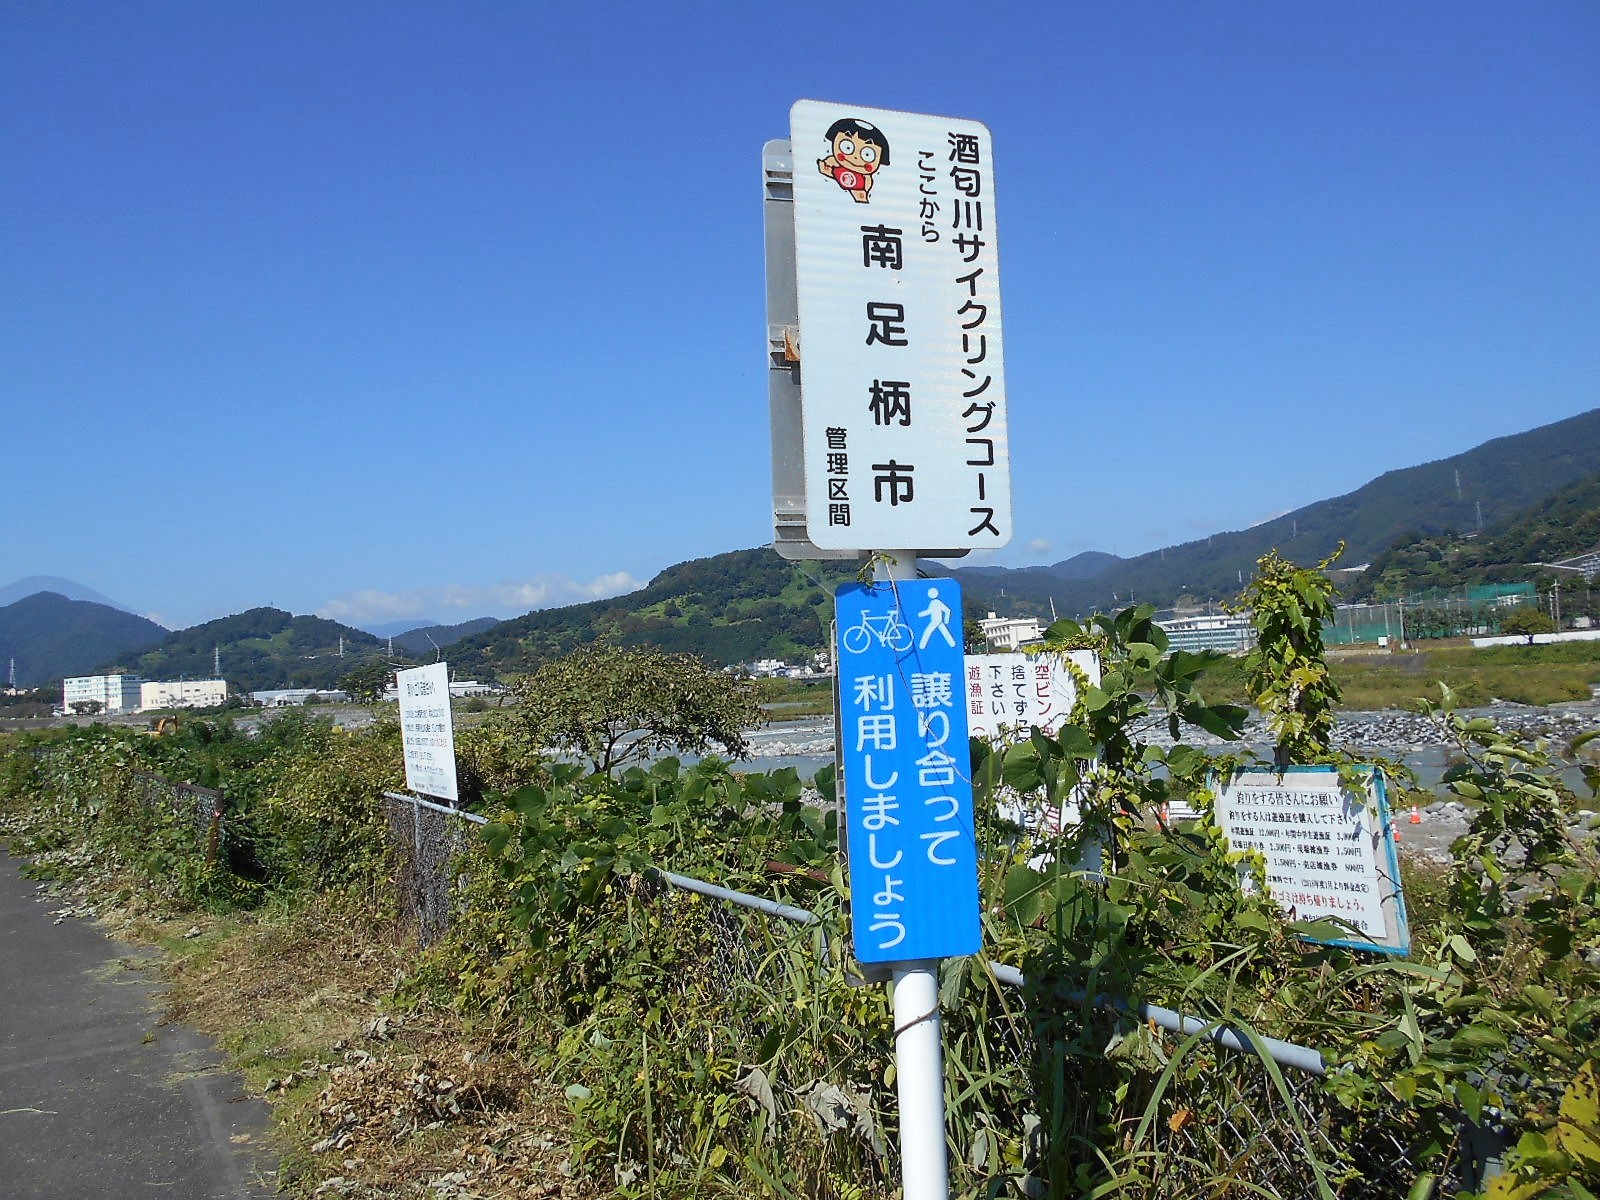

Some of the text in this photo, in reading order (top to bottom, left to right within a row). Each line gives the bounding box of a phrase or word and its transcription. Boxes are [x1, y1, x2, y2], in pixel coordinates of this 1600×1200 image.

[917, 150, 941, 243] ここから
[860, 224, 915, 507] 南足柄市
[947, 132, 1000, 536] 酒匂川サイクリングコース
[825, 427, 851, 527] 管理区間
[988, 664, 1006, 716] 下さい
[1034, 664, 1056, 738] 空ビン
[853, 673, 907, 950] 利用しましょう
[910, 671, 962, 866] 譲り合って
[1236, 791, 1338, 807] 釣りをする皆さんにお願い
